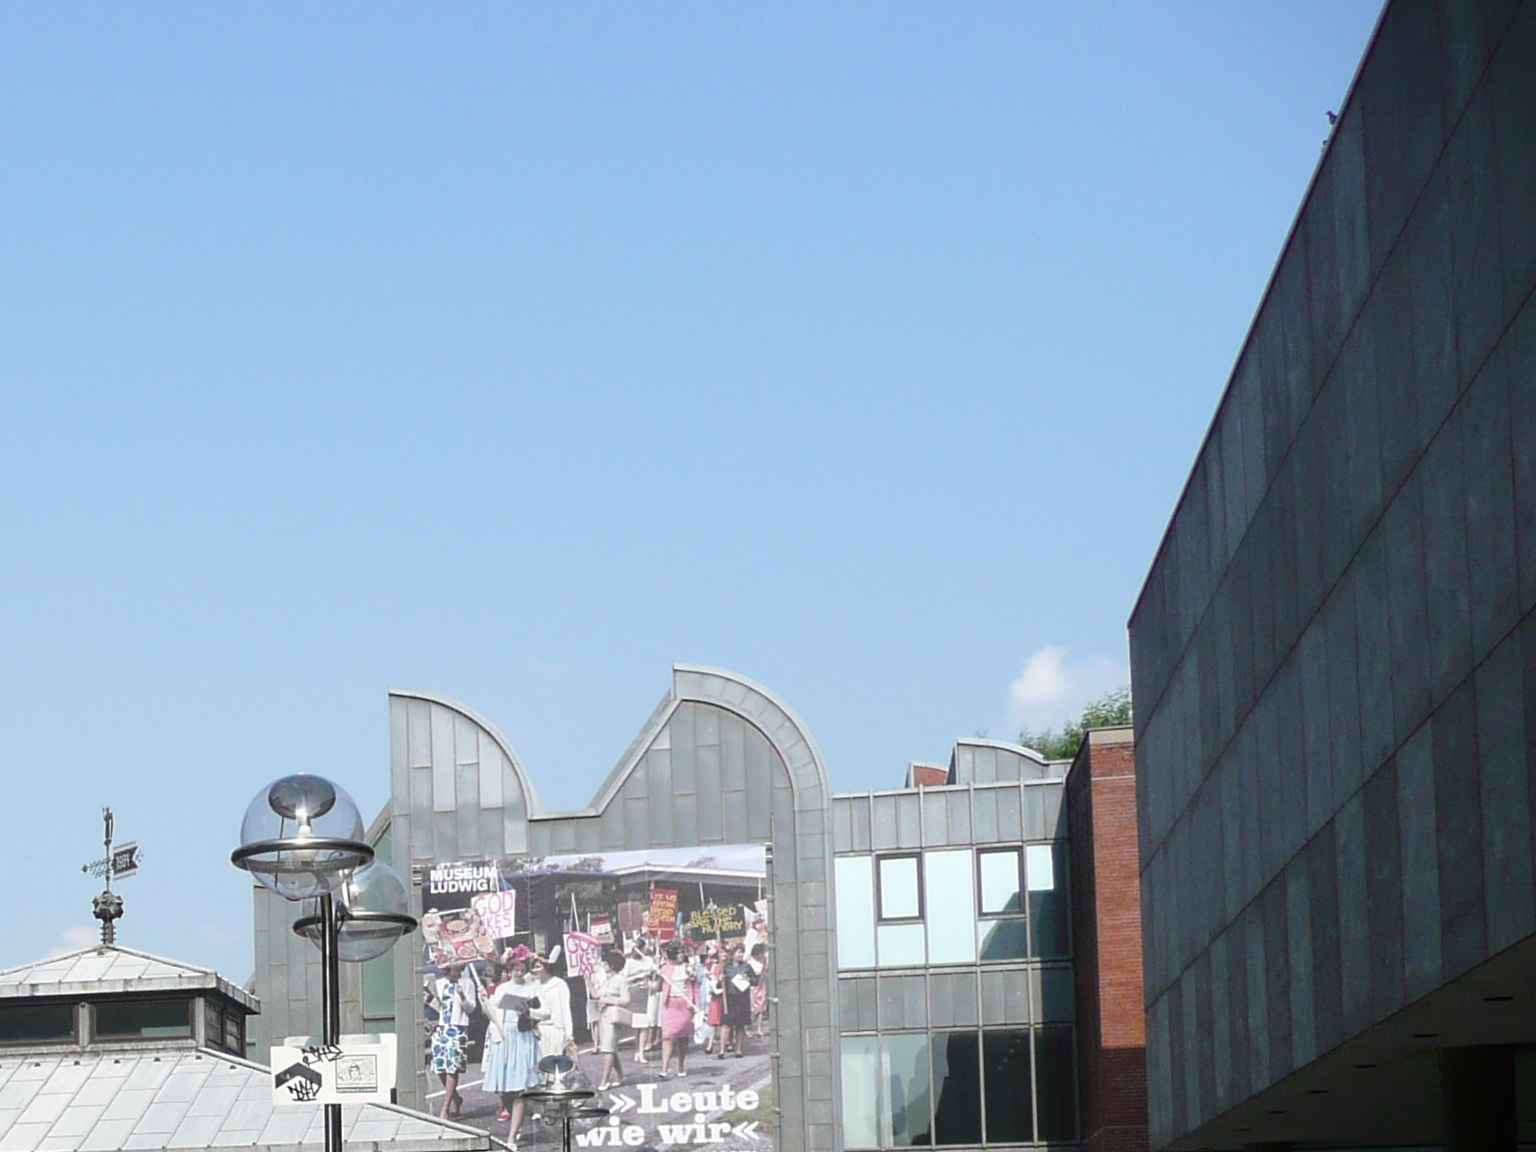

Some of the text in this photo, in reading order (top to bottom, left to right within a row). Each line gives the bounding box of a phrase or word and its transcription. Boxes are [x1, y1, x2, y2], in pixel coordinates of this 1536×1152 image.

[430, 867, 496, 881] MUSEUM
[430, 879, 488, 894] LUDWIG
[473, 892, 514, 917] GOD
[576, 1116, 645, 1147] wie
